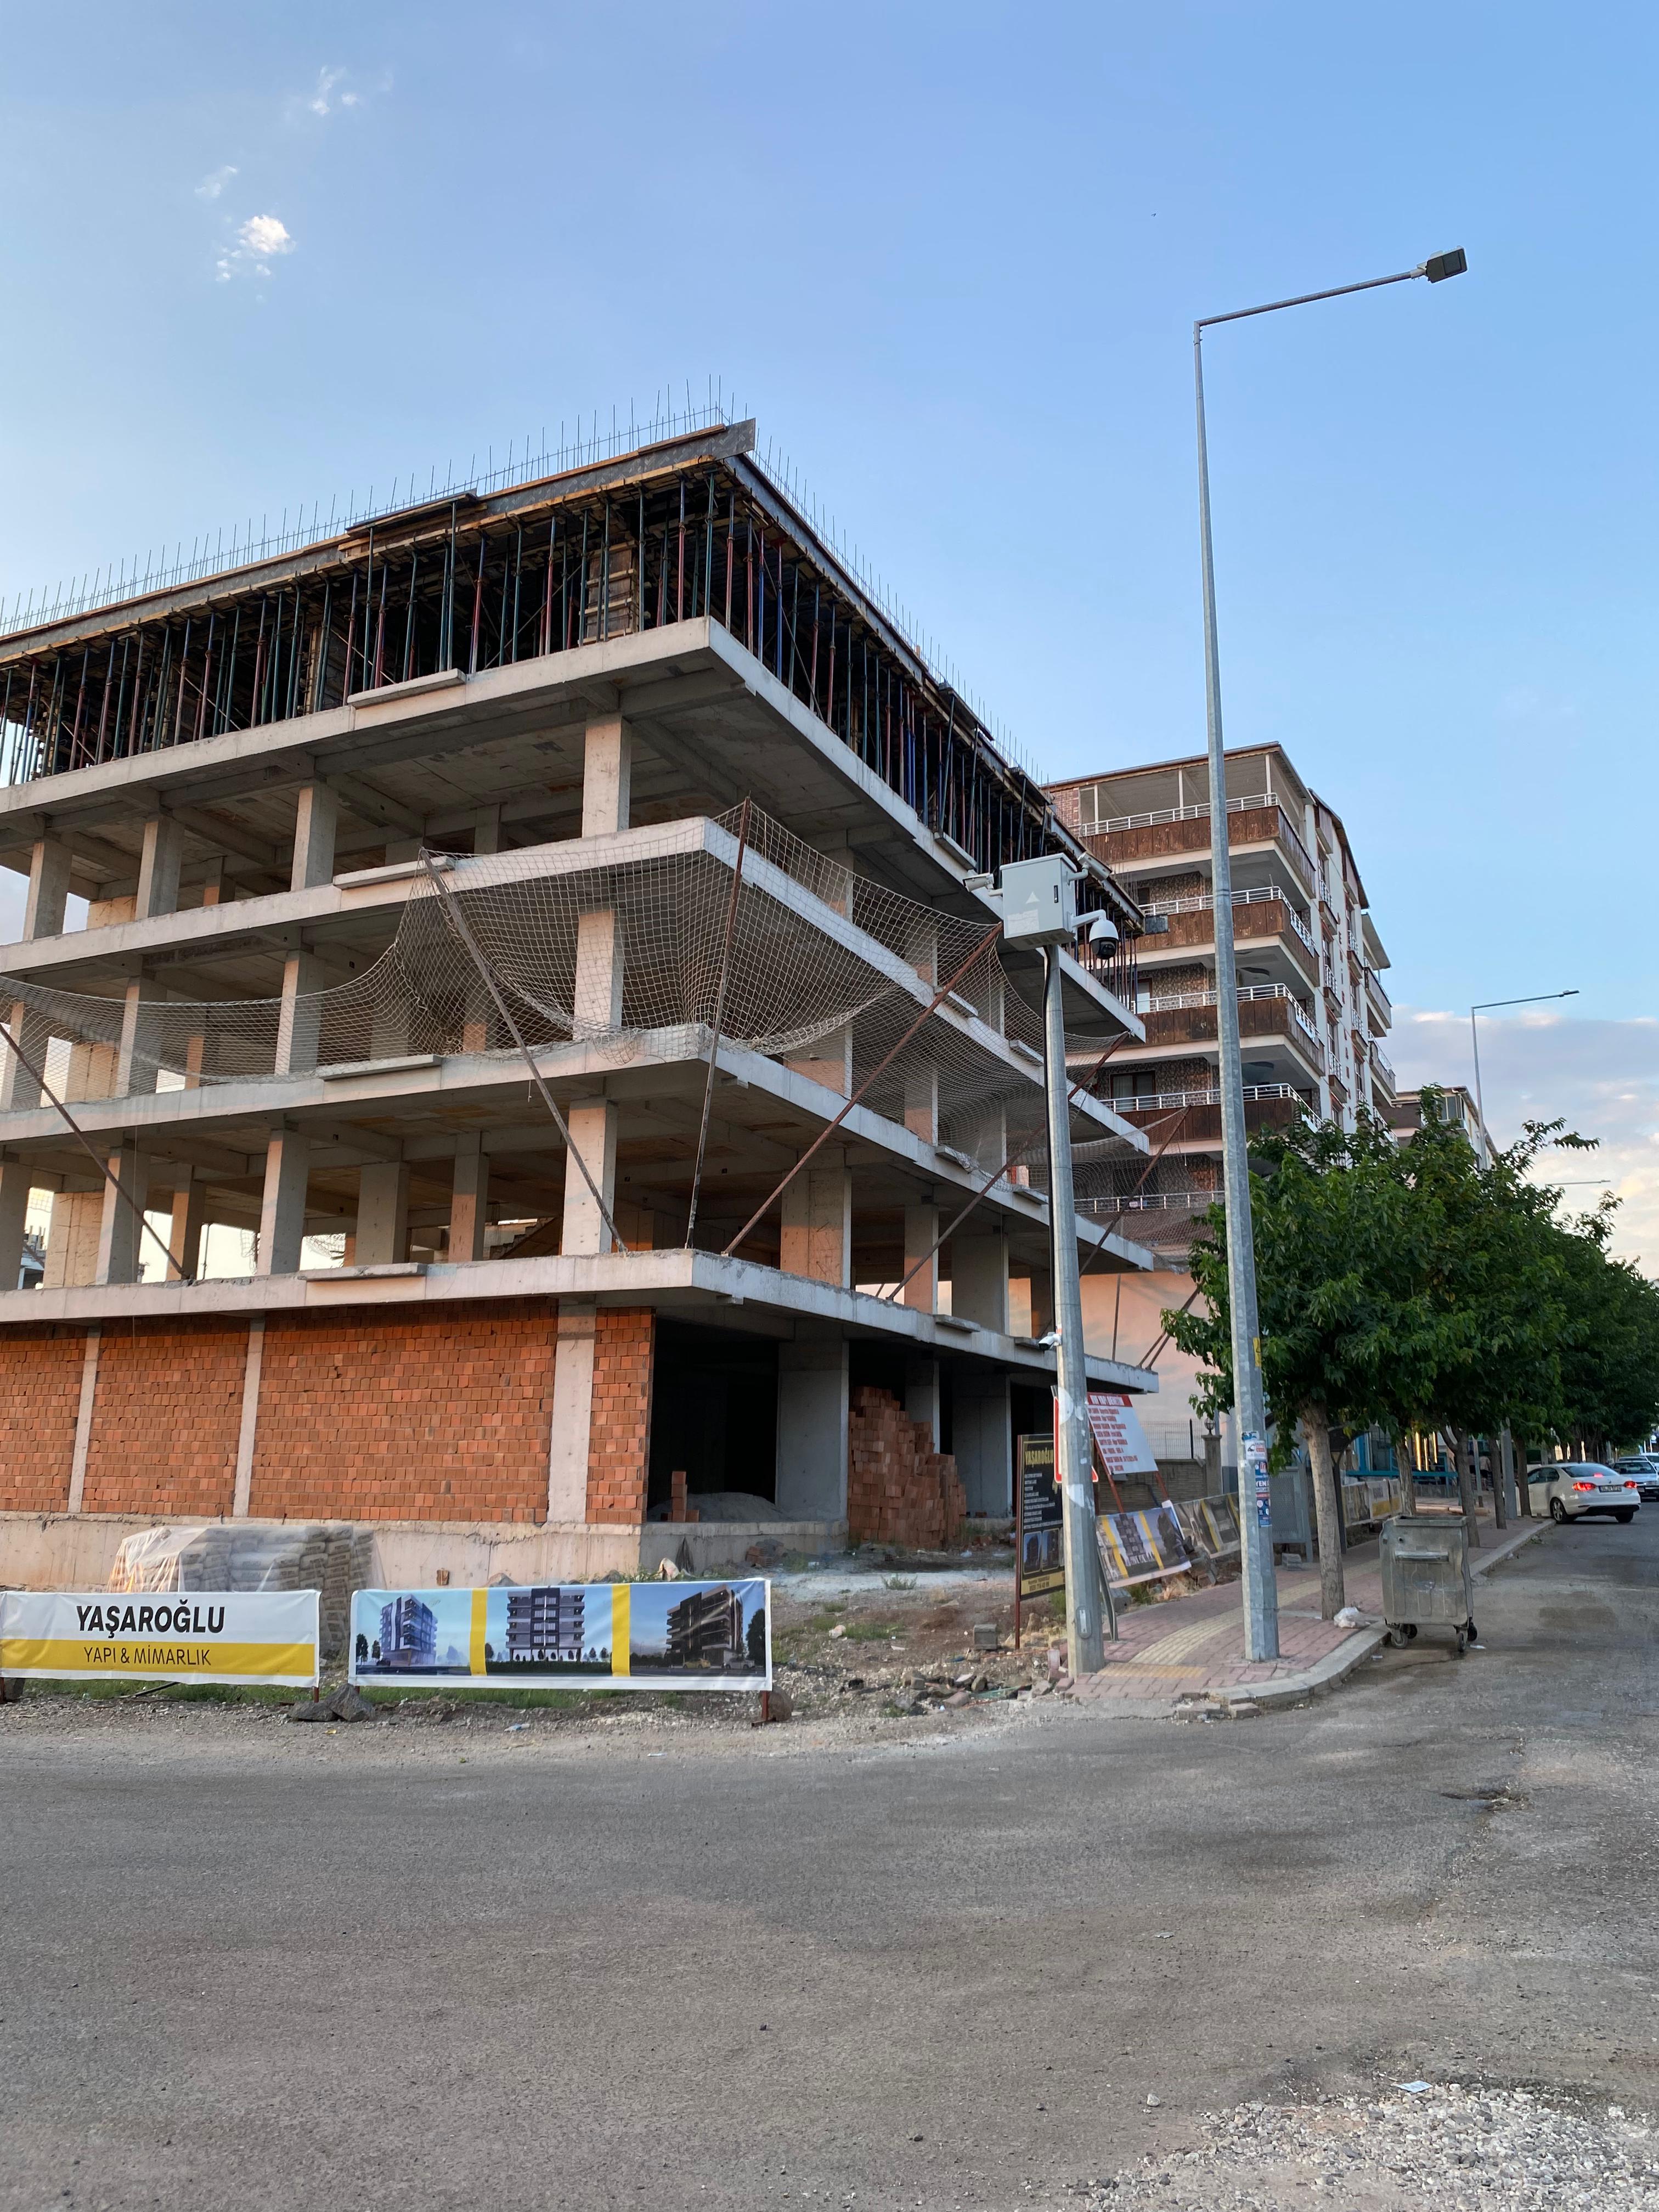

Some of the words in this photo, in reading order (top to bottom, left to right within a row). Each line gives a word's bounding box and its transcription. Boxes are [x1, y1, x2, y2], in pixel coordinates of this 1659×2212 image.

[1025, 1447, 1054, 1468] YAŞAROĞLU
[76, 1599, 225, 1639] YAŞAROĞLU
[83, 1647, 116, 1663] YAPI
[120, 1647, 130, 1664] &
[134, 1644, 212, 1666] MİMARLIK
